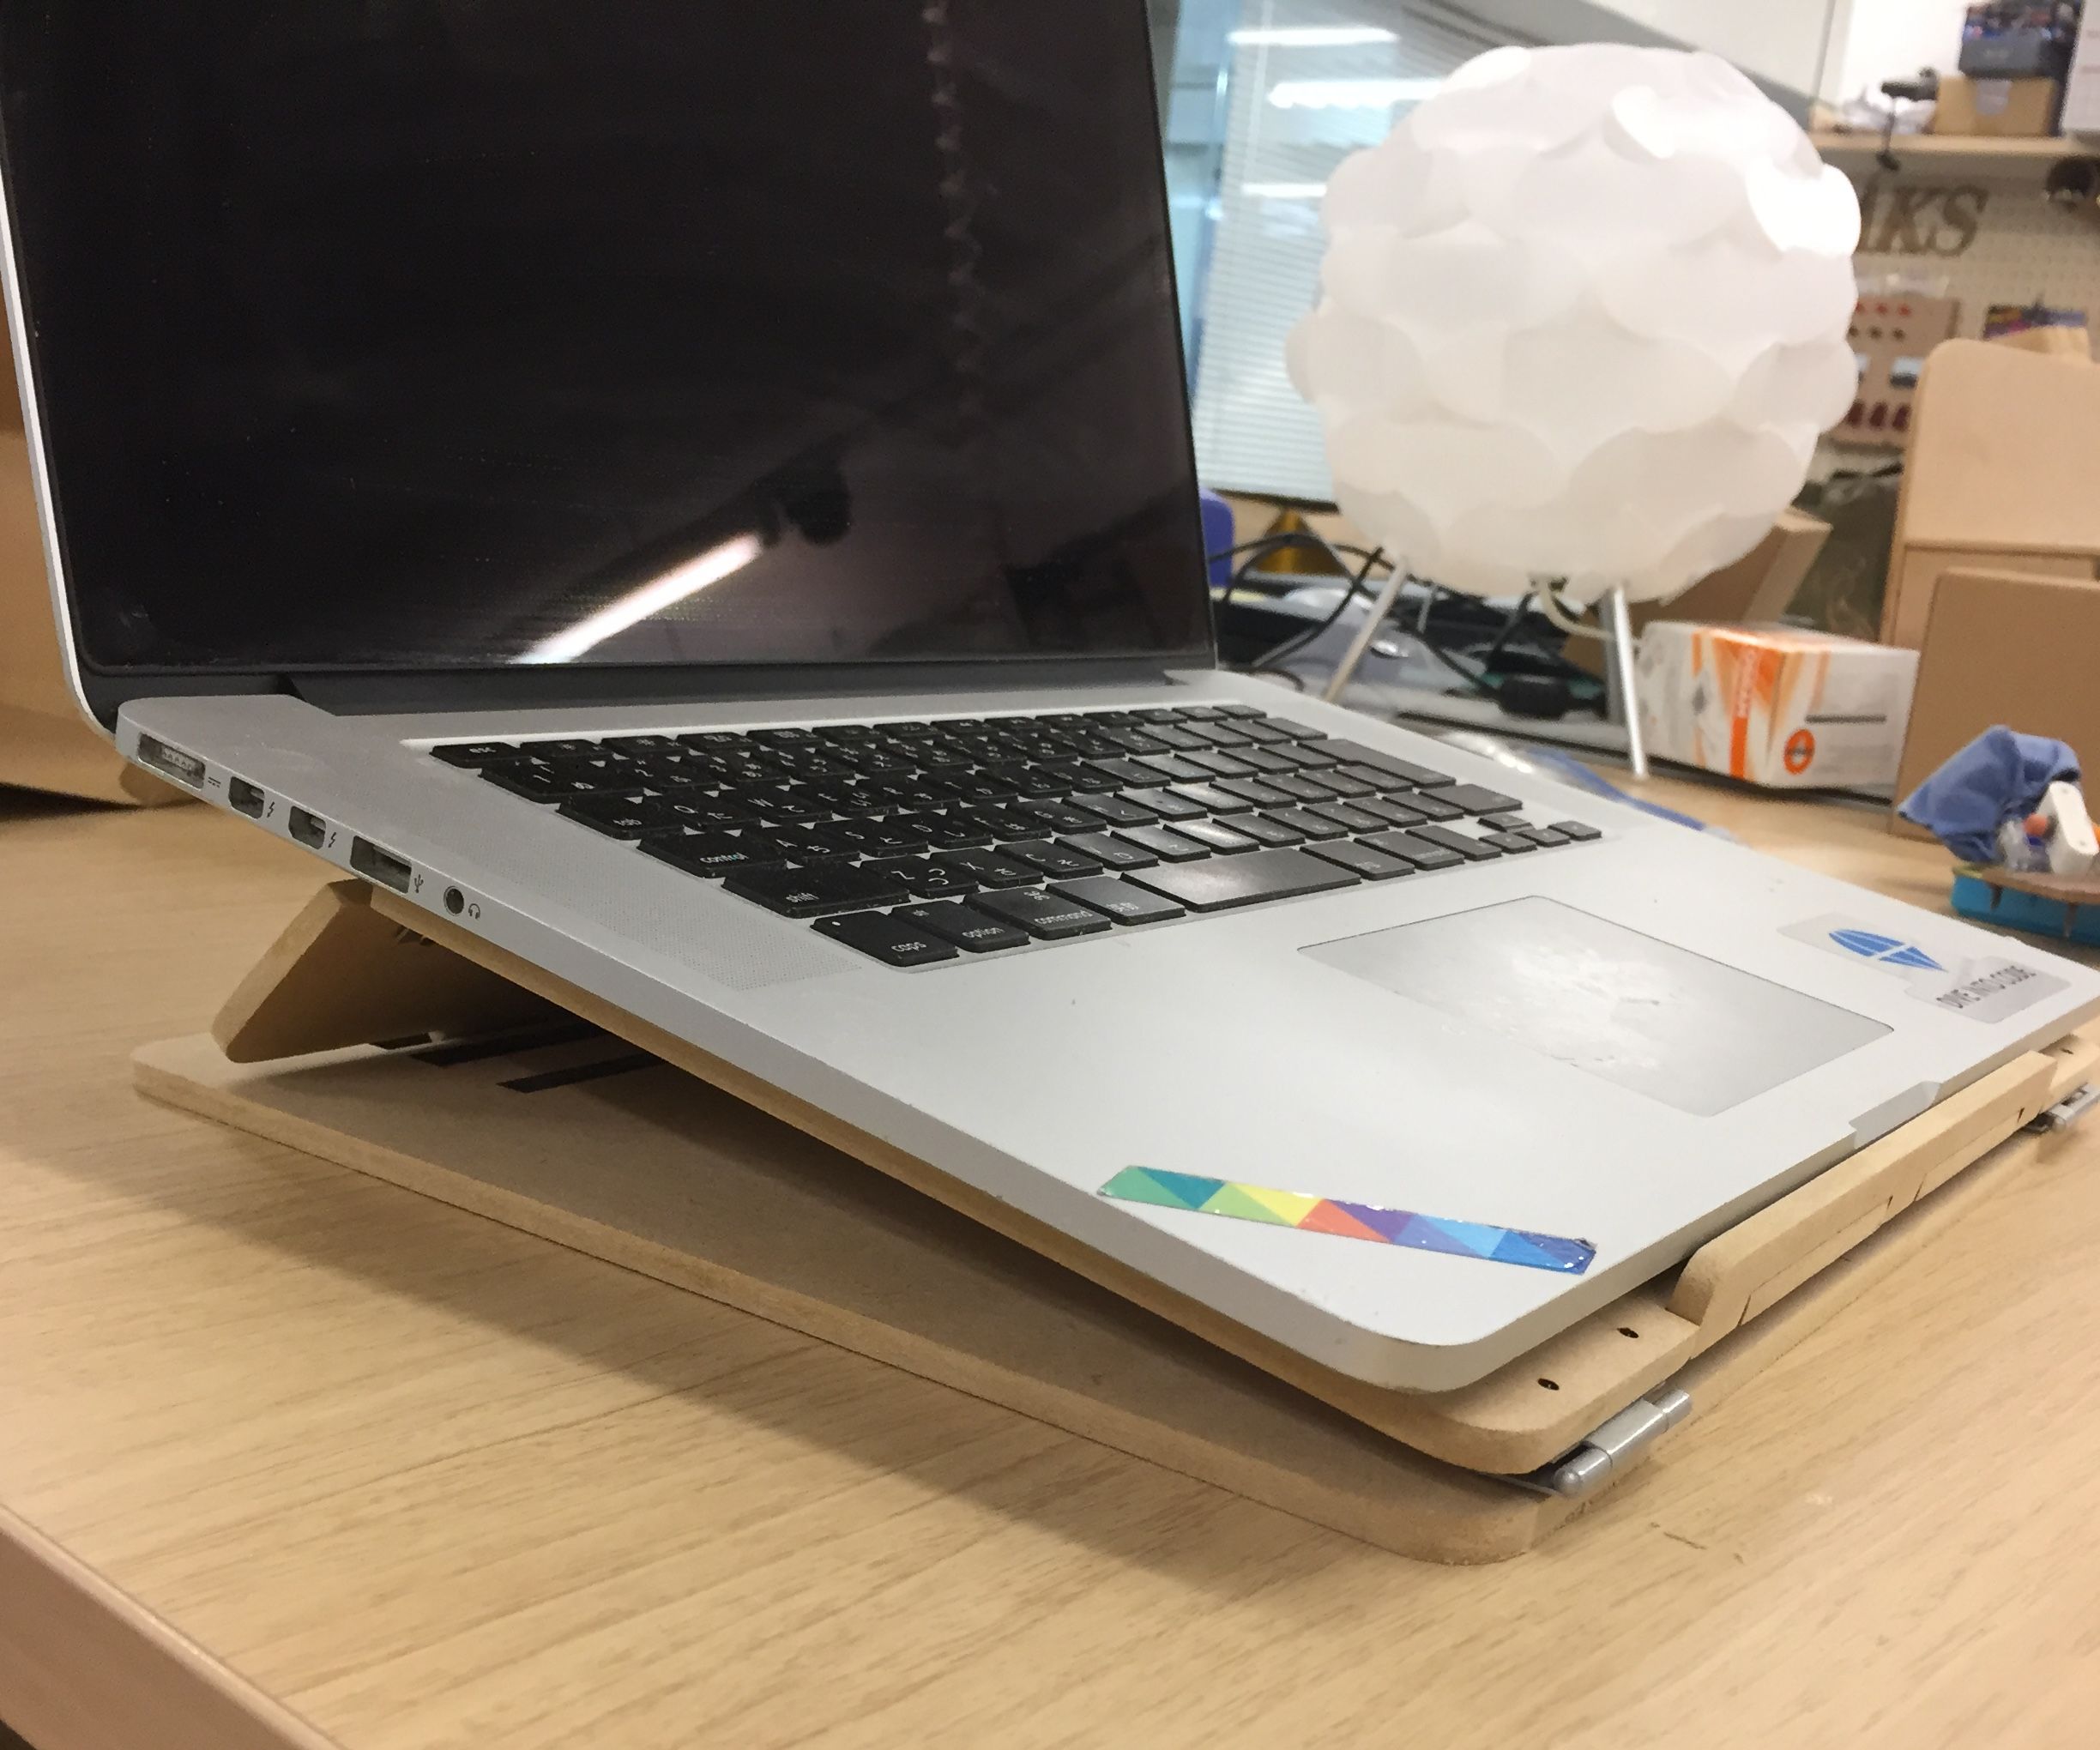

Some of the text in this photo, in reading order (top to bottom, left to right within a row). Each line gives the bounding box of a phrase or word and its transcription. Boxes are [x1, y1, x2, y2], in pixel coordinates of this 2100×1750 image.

[700, 852, 750, 864] control
[786, 892, 820, 903] shift
[1033, 910, 1094, 925] command
[961, 926, 1005, 938] option
[890, 941, 927, 952] caps
